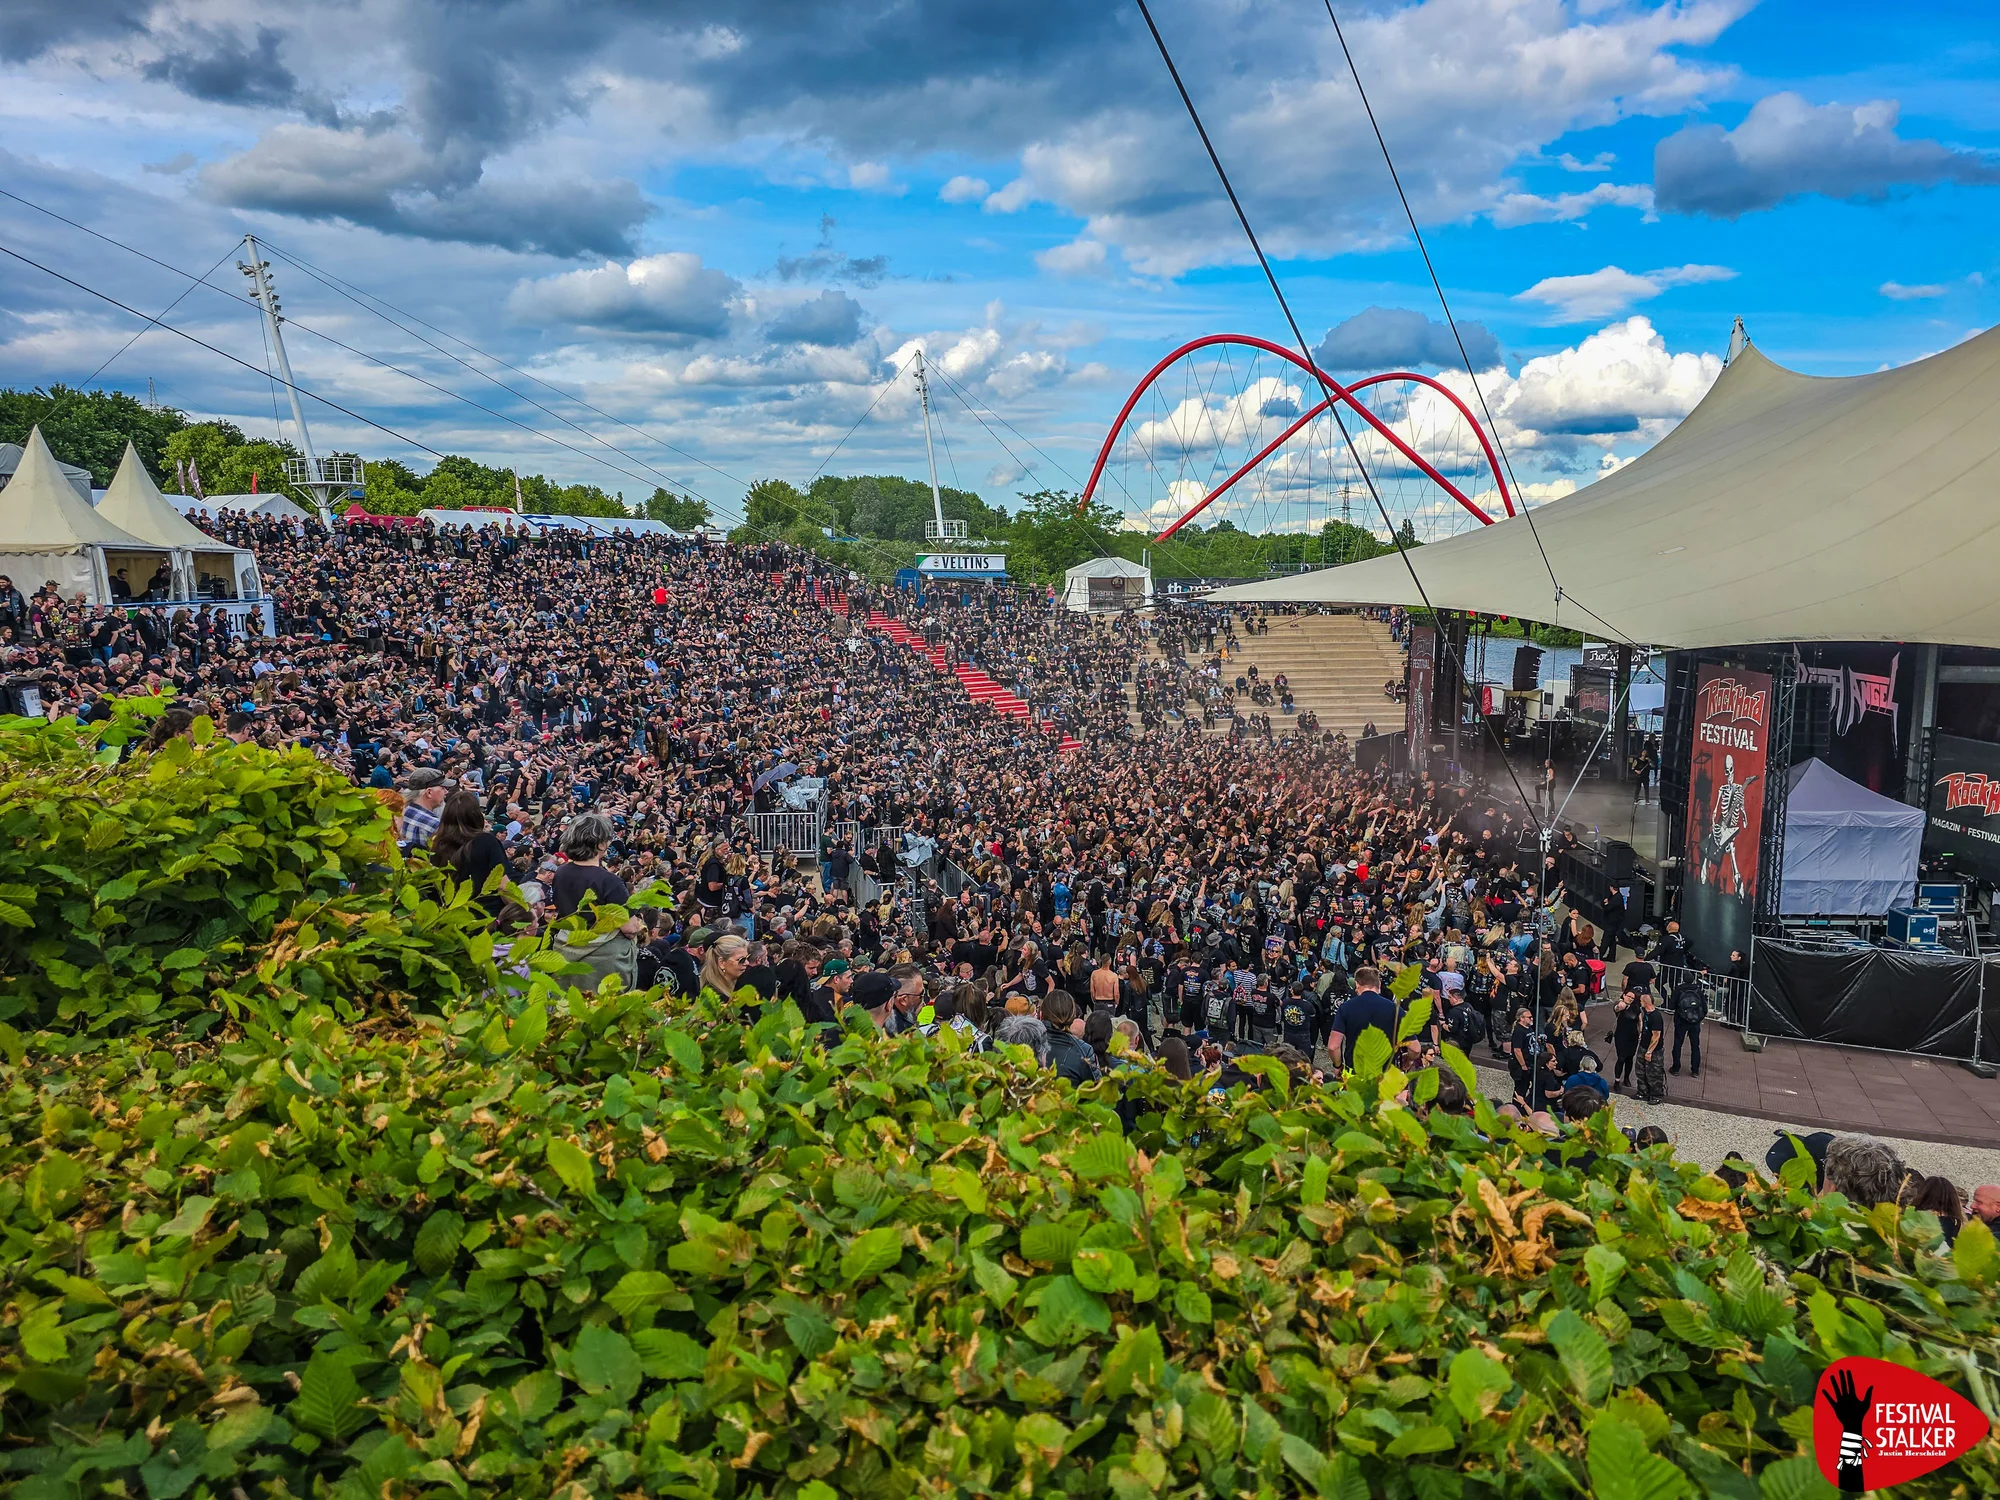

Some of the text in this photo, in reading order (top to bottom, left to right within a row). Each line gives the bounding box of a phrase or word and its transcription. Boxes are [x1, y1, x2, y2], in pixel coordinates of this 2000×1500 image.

[942, 556, 989, 569] VELTINS
[1700, 722, 1759, 752] FESTIVAL
[1931, 817, 2000, 844] MAGAZIN FESTIVAL
